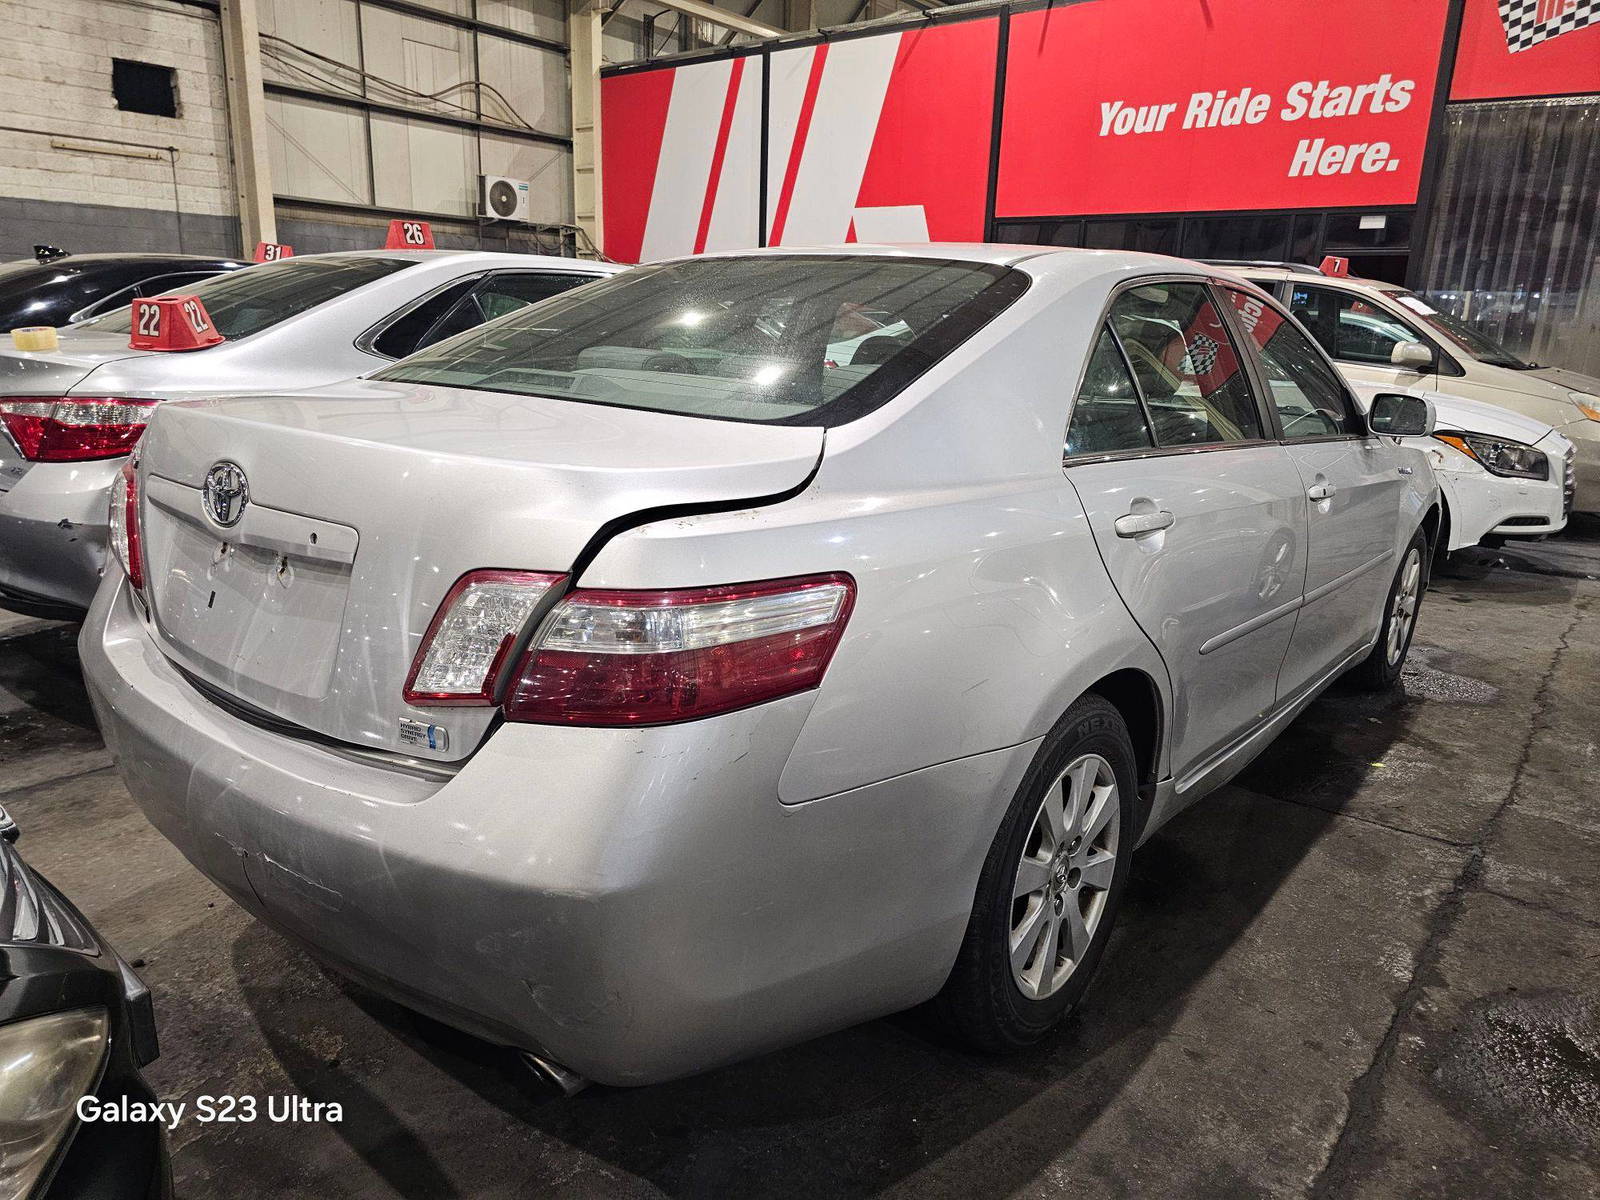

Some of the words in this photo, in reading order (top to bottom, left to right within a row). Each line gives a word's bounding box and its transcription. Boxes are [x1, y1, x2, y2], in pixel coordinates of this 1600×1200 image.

[1099, 101, 1177, 136] Your
[1182, 88, 1271, 129] Ride
[1280, 74, 1415, 121] Starts
[1287, 138, 1400, 177] Here.
[403, 223, 425, 245] 26
[265, 244, 282, 260] 31
[1333, 259, 1341, 273] 7
[139, 304, 160, 336] 22
[183, 300, 209, 333] 22
